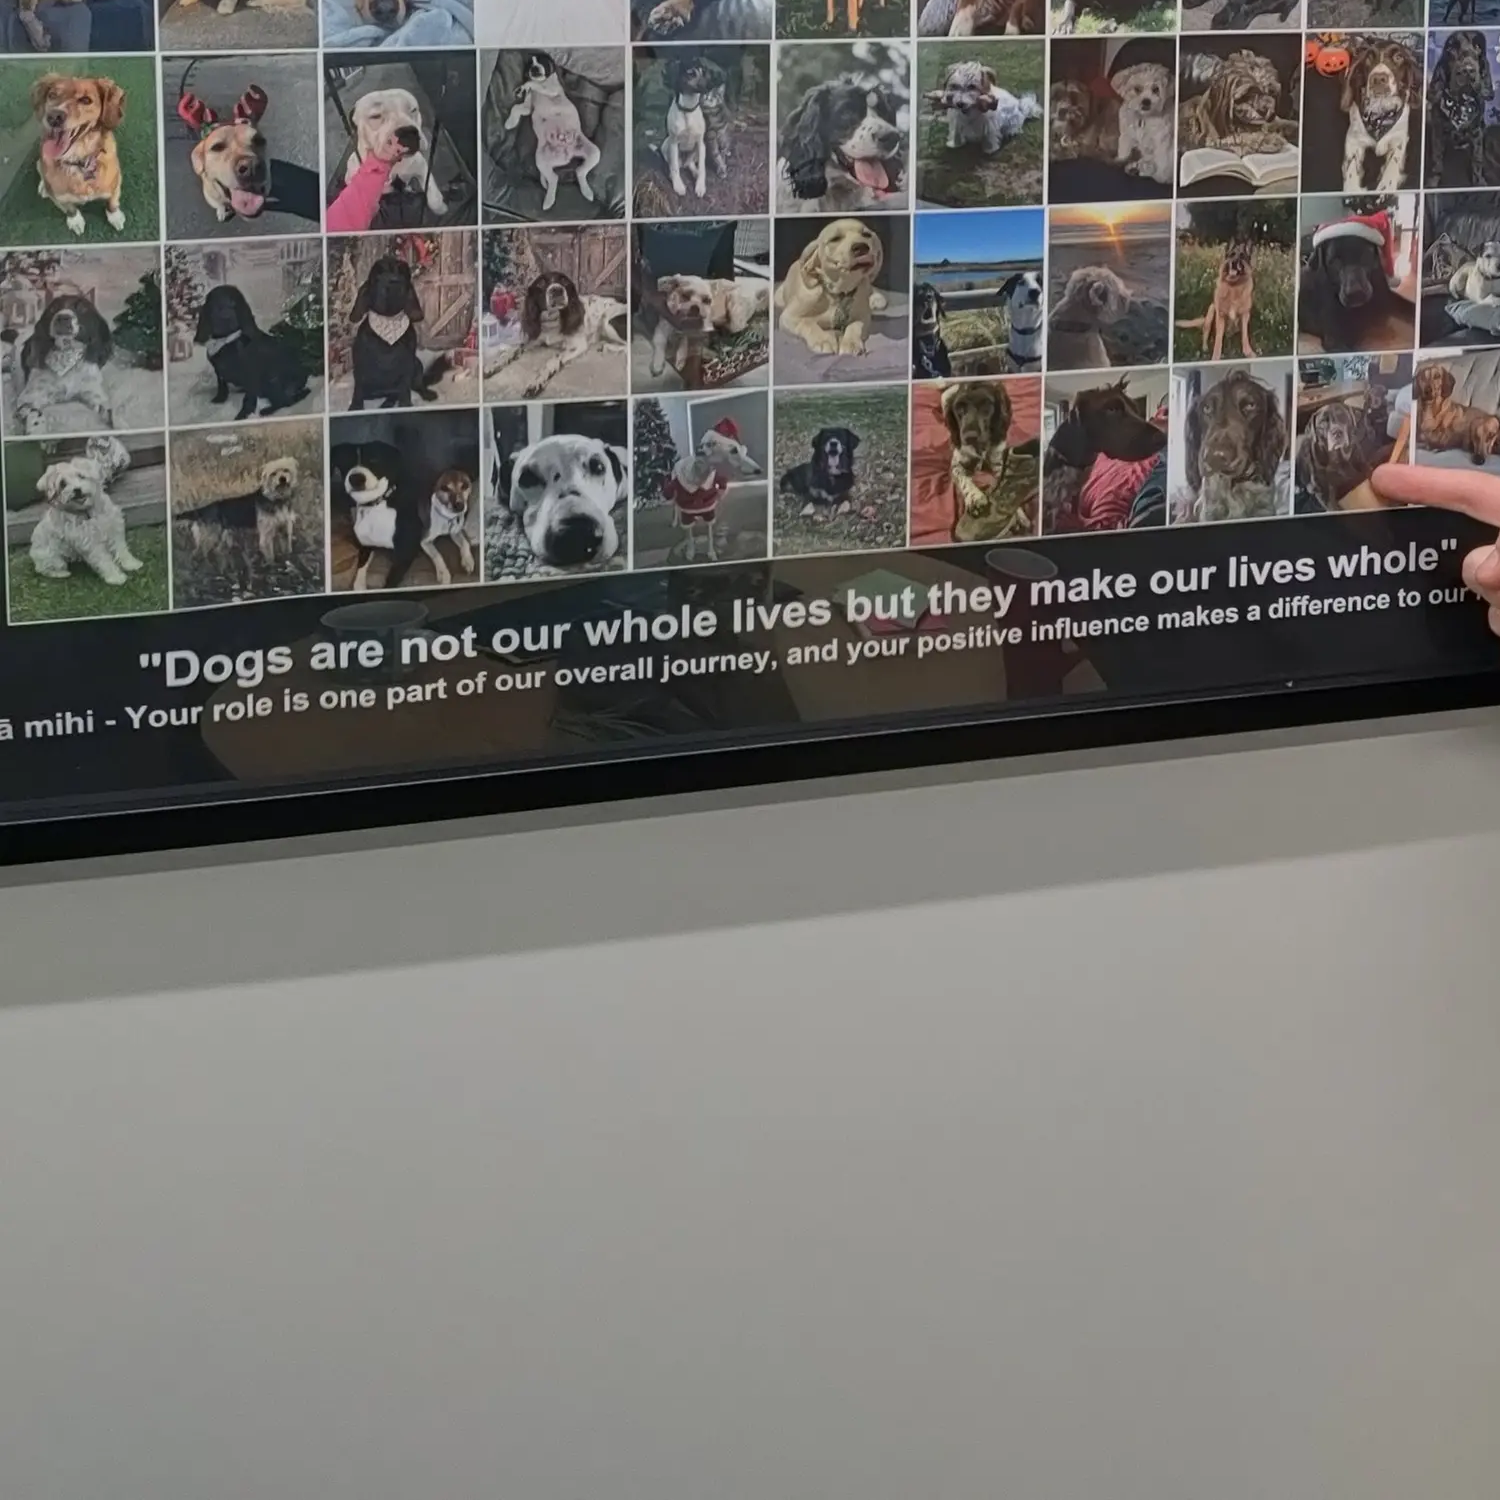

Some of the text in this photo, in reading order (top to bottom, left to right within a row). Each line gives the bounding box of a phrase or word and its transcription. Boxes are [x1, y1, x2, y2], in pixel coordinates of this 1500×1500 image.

[24, 709, 95, 739] mihi
[124, 701, 204, 730] Your
[213, 692, 273, 722] role
[283, 687, 310, 713] is
[319, 687, 377, 710] one
[386, 675, 447, 711] part
[455, 670, 487, 696] of
[494, 670, 548, 692] our
[554, 655, 653, 687] overall
[659, 650, 778, 690] journey,
[786, 636, 839, 666] and
[846, 635, 912, 670] your
[917, 624, 1023, 659] positive
[1031, 614, 1150, 643] influence
[1157, 604, 1240, 630] makes
[1246, 604, 1261, 622] a
[1267, 588, 1391, 619] difference
[1396, 587, 1422, 608] to
[1428, 586, 1470, 605] our
[139, 538, 1457, 688] "Dogs are not our whole lives but they make our lives whole"
